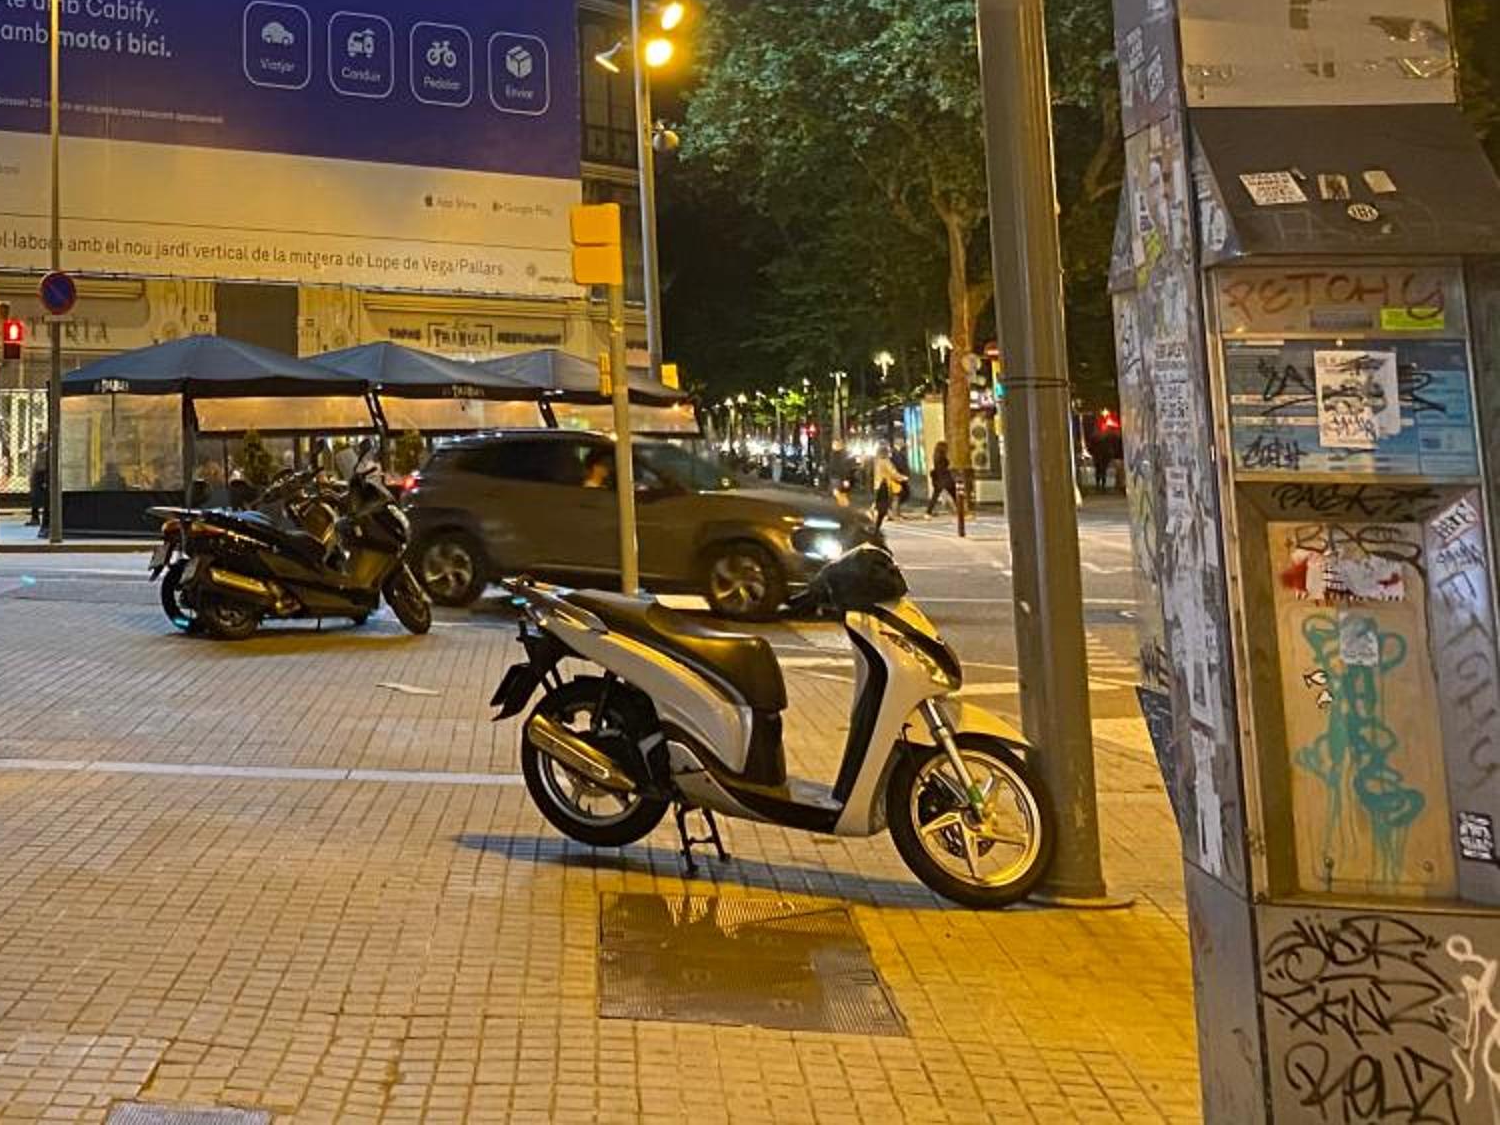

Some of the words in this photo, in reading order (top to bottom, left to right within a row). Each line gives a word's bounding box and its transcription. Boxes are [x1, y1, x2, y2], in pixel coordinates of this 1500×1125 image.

[0, 21, 50, 44] amb
[56, 27, 111, 51] moto
[115, 30, 122, 53] i
[127, 32, 172, 58] bici.
[67, 234, 100, 252] amb
[105, 235, 120, 254] el
[124, 241, 151, 256] nou
[192, 243, 248, 261] vertical
[252, 246, 269, 262] de
[273, 247, 286, 263] la
[289, 251, 344, 269] mitgera
[347, 251, 363, 267] de
[367, 252, 399, 271] Lope
[403, 253, 419, 271] de
